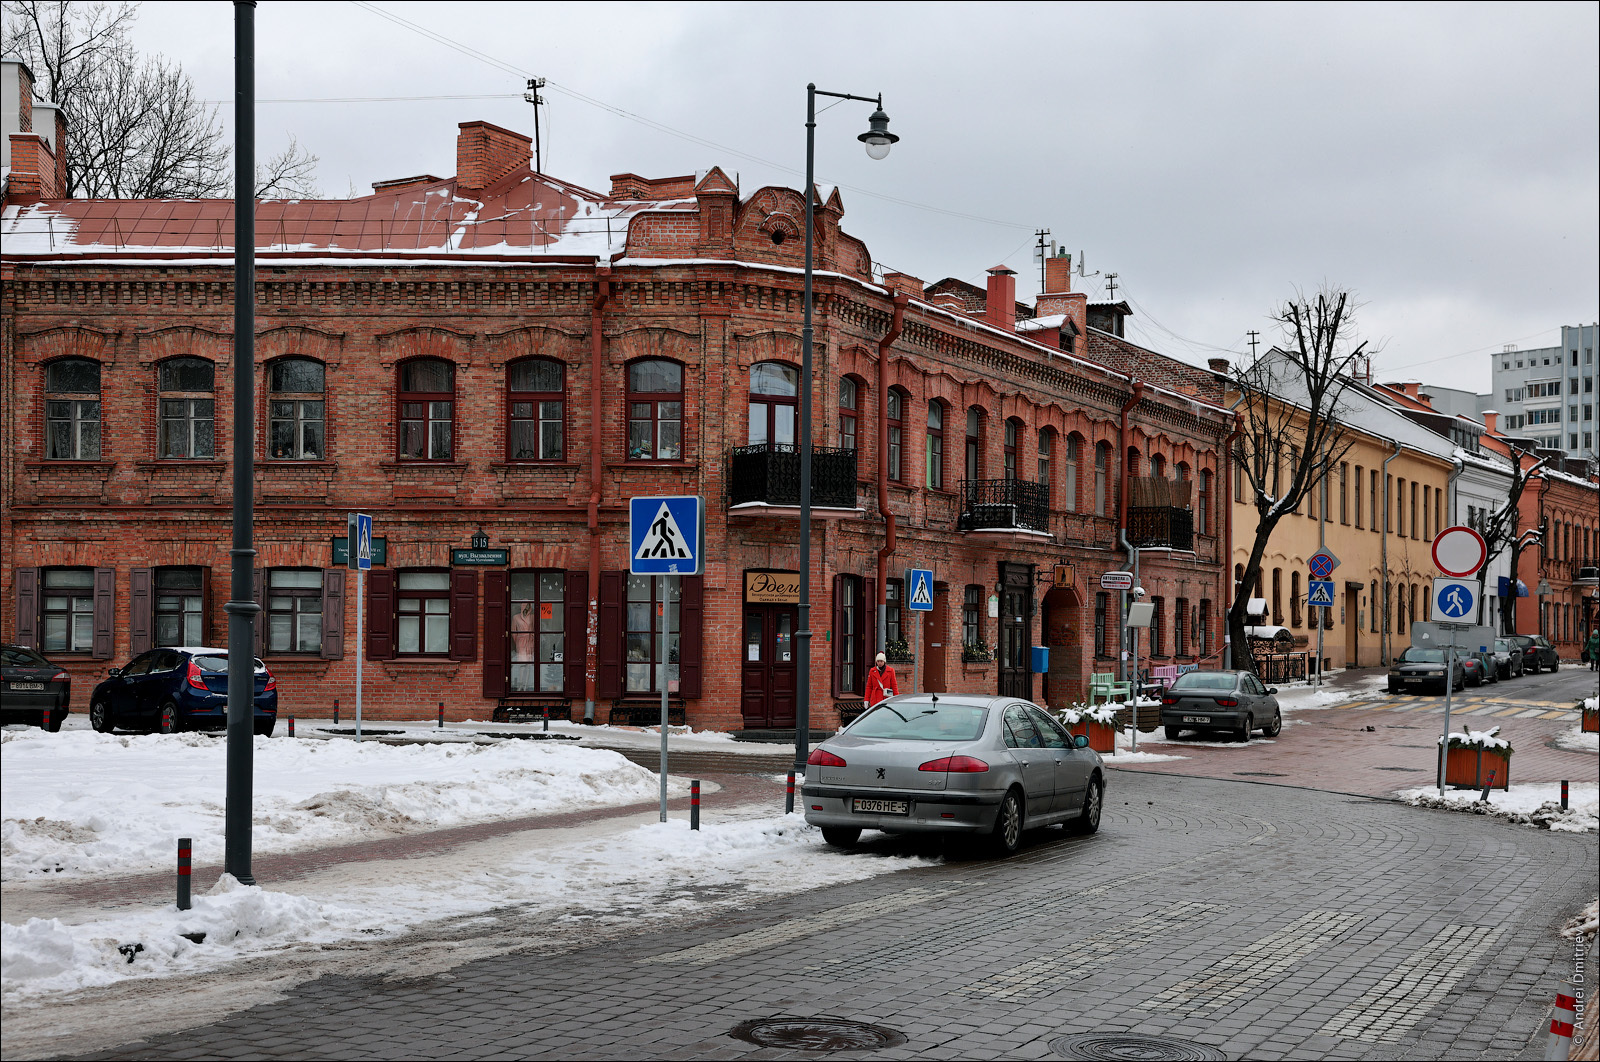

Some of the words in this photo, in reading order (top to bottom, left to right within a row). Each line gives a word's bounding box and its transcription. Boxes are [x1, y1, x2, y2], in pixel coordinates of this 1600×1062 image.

[473, 537, 479, 548] 15
[480, 537, 487, 548] 15
[861, 800, 882, 811] 0376
[883, 802, 908, 812] HE-5
